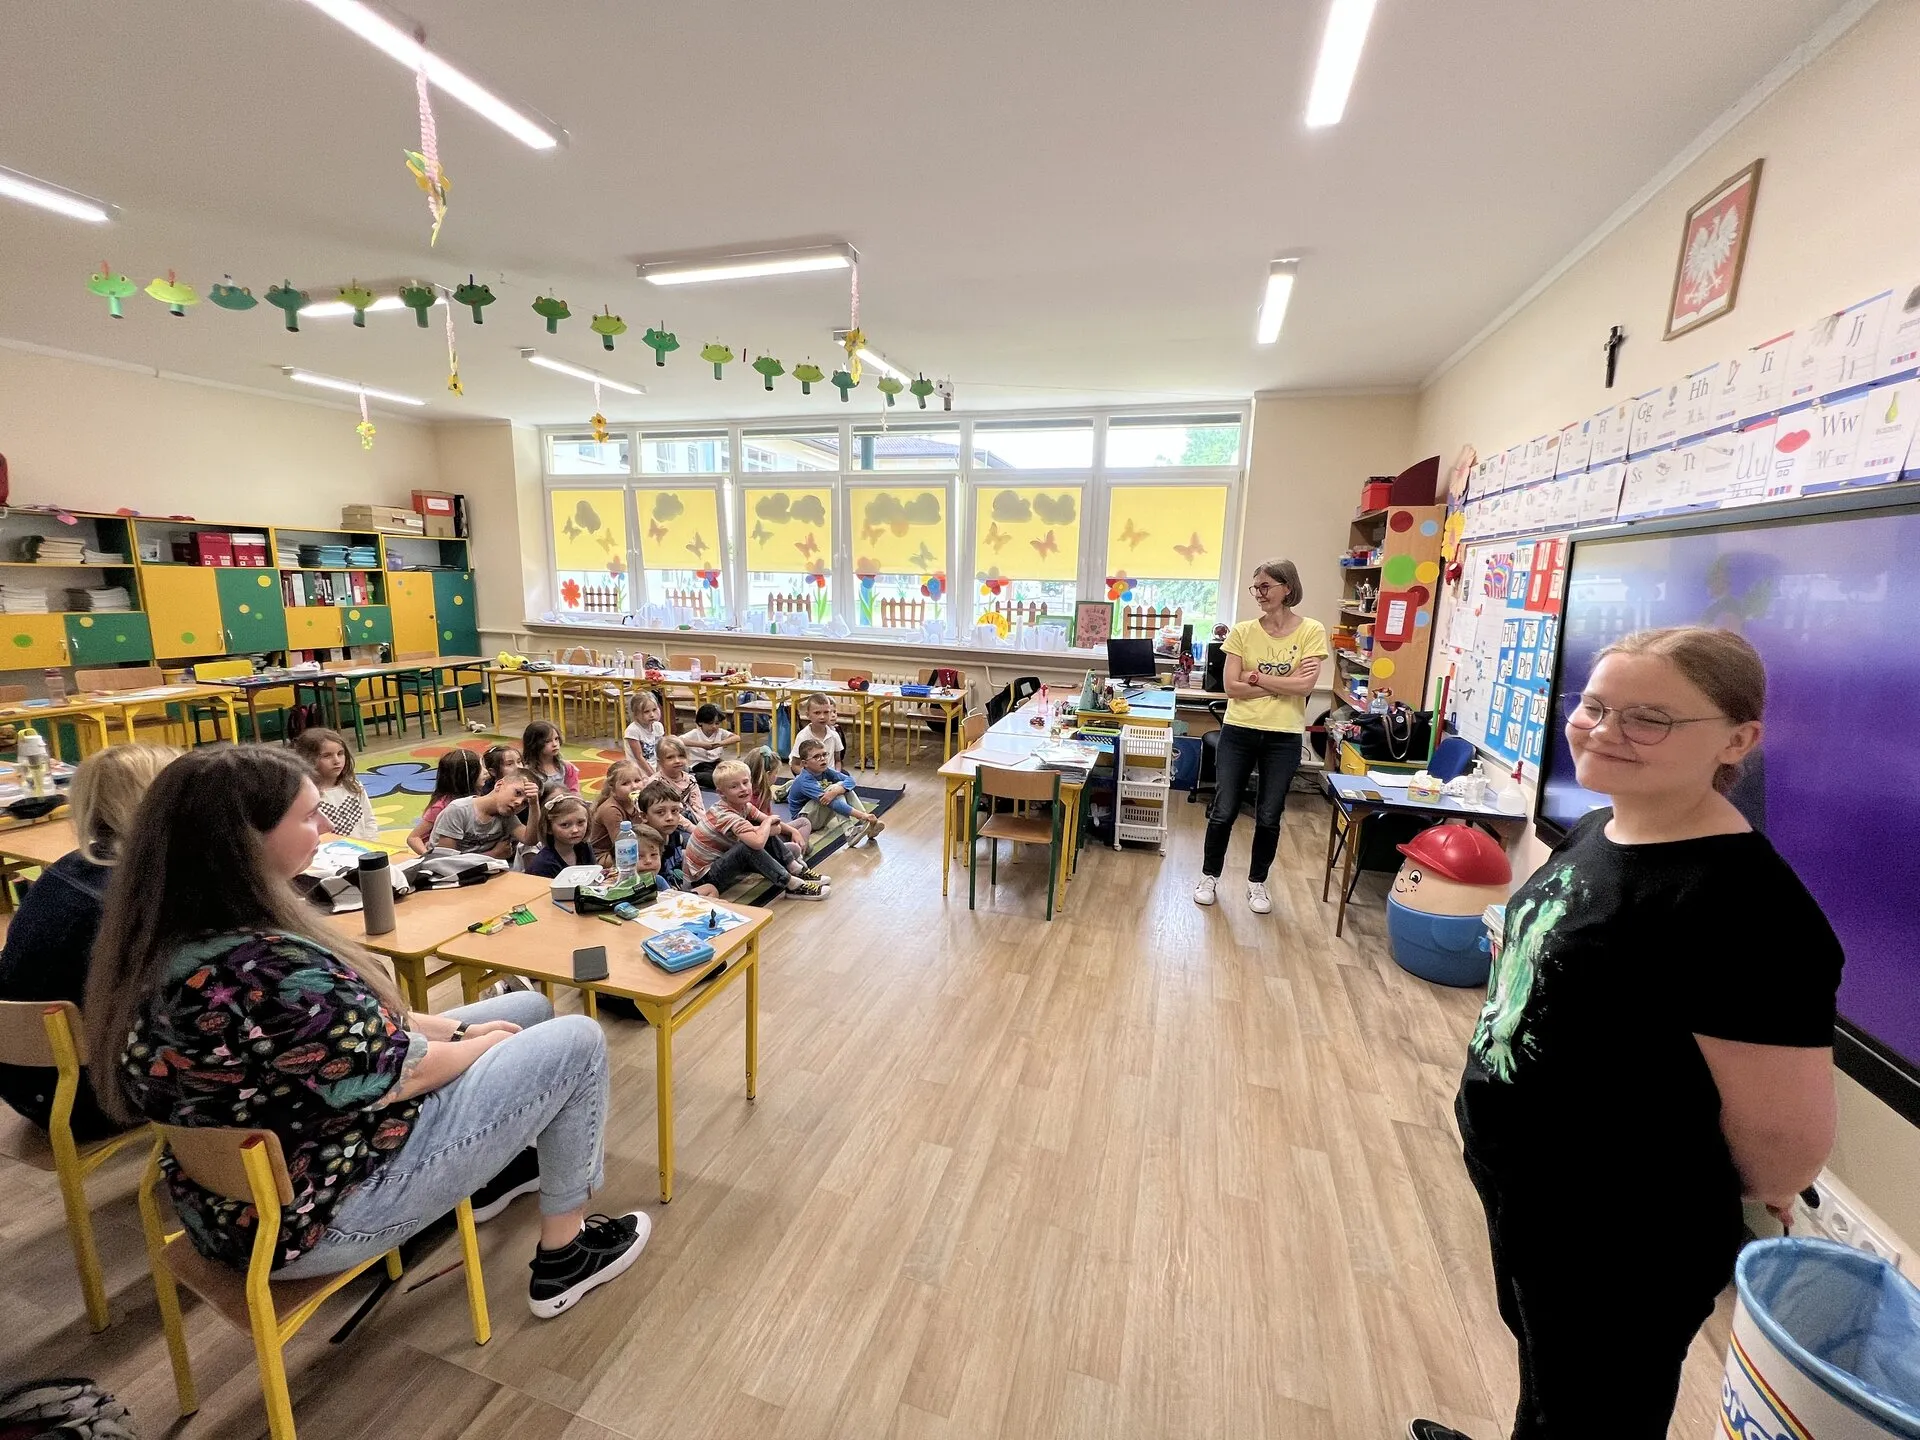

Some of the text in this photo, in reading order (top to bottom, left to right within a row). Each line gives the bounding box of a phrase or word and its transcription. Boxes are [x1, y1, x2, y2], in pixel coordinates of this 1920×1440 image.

[1846, 313, 1867, 348] Jj
[1760, 350, 1775, 374] Ii
[1689, 377, 1709, 401] Hh
[1637, 401, 1654, 423] Gg
[1822, 411, 1860, 438] Ww
[1683, 452, 1697, 472] Tt
[1736, 442, 1768, 480] Uu
[1630, 466, 1643, 484] Ss
[1518, 657, 1531, 679] Pp
[1530, 698, 1547, 719] Dd
